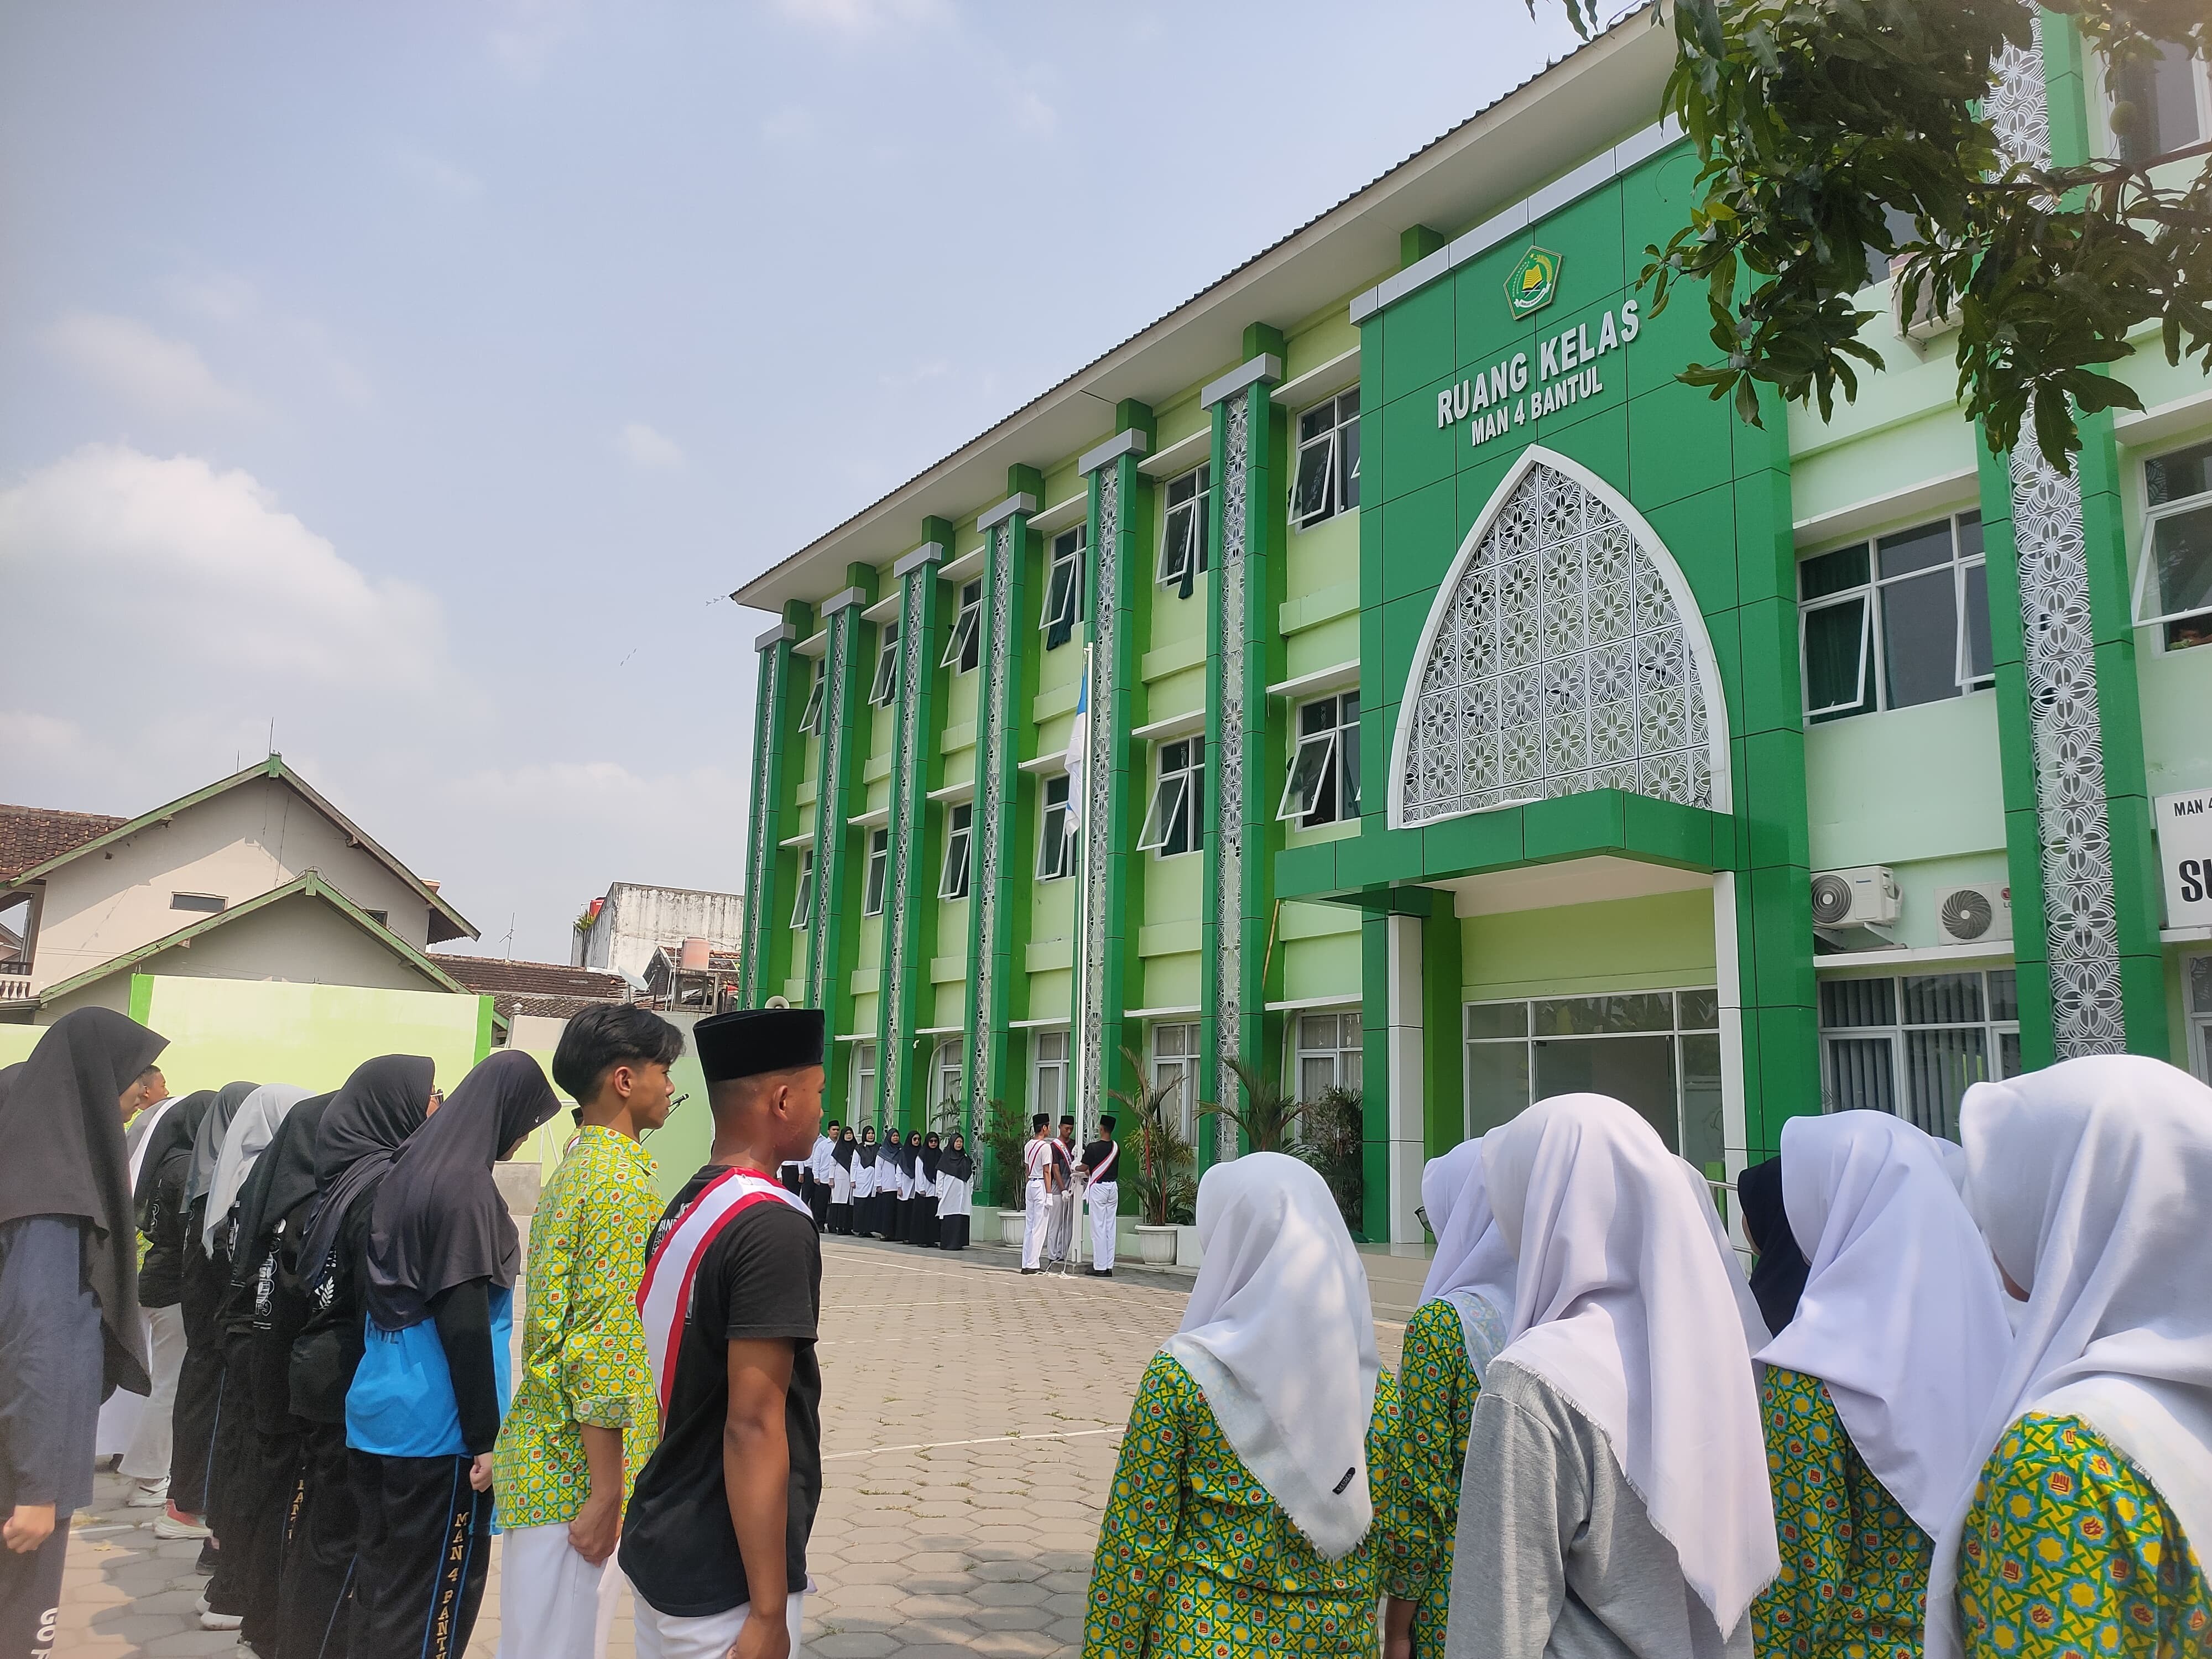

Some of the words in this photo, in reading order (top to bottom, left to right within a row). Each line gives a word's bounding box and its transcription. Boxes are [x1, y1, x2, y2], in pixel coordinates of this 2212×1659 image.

[1438, 353, 1527, 429] RUANG
[1540, 299, 1639, 381] KELAS
[1472, 406, 1509, 447] MAN
[1514, 399, 1525, 425] 4
[1531, 366, 1603, 420] BANTUL
[2174, 799, 2203, 817] MAN
[450, 1512, 469, 1561] MAN
[447, 1568, 459, 1582] 4
